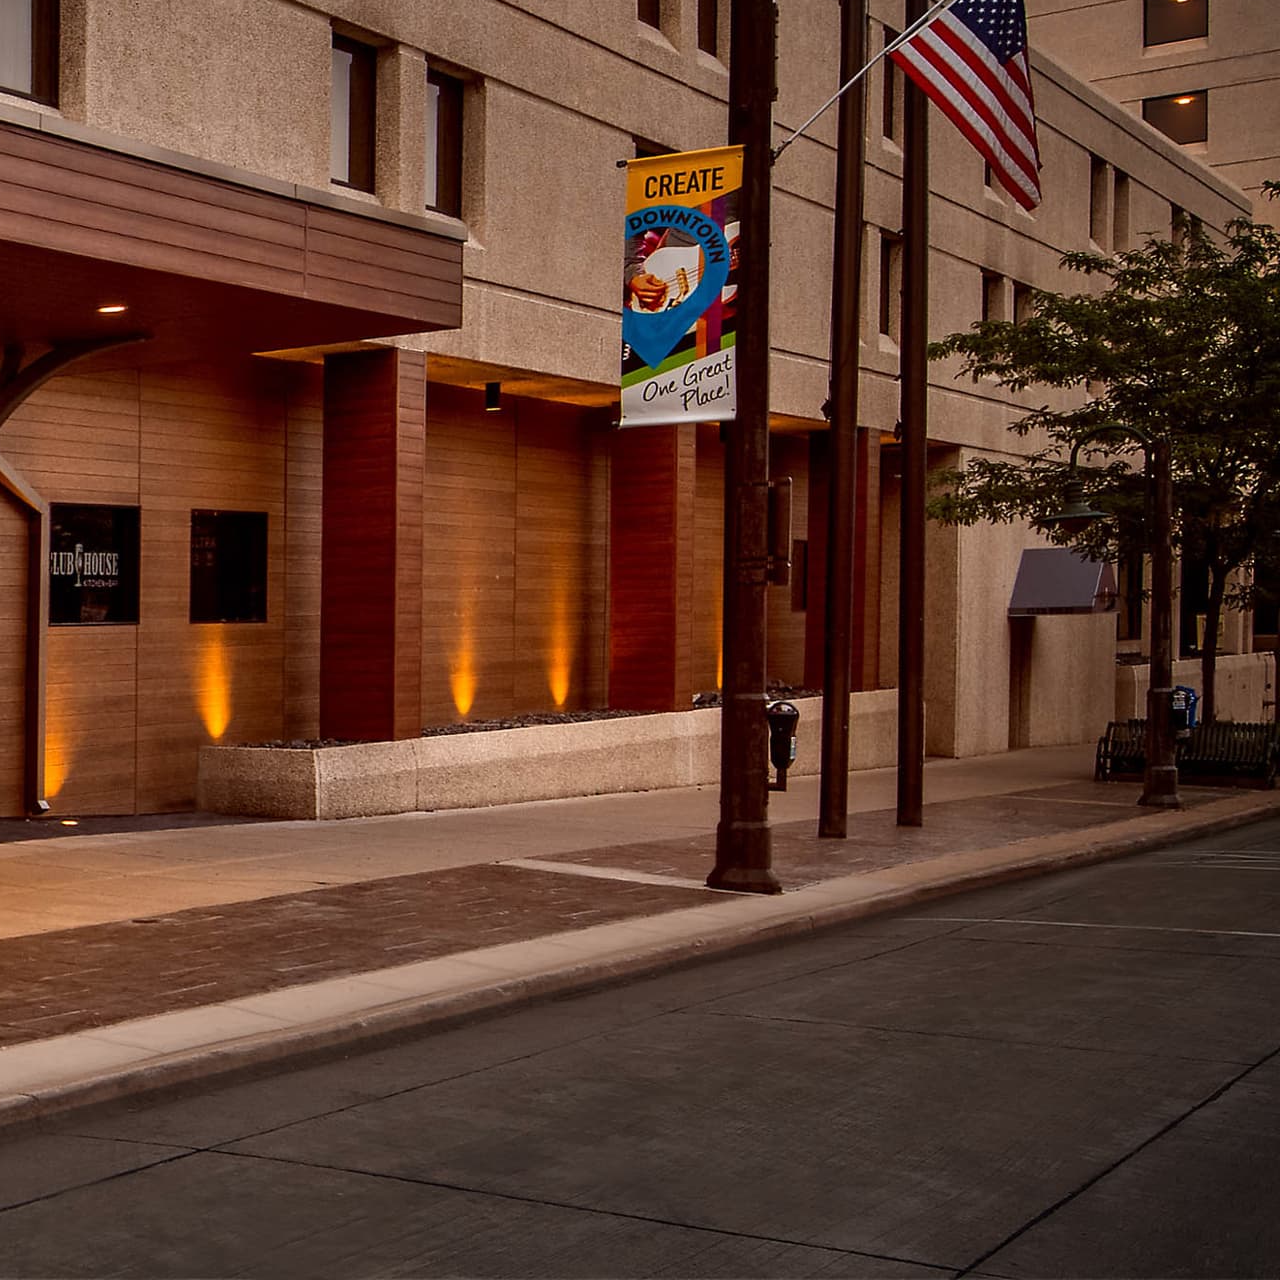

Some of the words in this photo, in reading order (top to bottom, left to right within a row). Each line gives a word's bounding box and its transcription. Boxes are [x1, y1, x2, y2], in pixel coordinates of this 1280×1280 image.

[645, 166, 725, 199] CREATE
[629, 210, 726, 265] DOWNTOWN
[642, 380, 678, 402] One
[682, 353, 733, 388] Great
[680, 380, 731, 412] Place!
[83, 552, 119, 576] HOUSE
